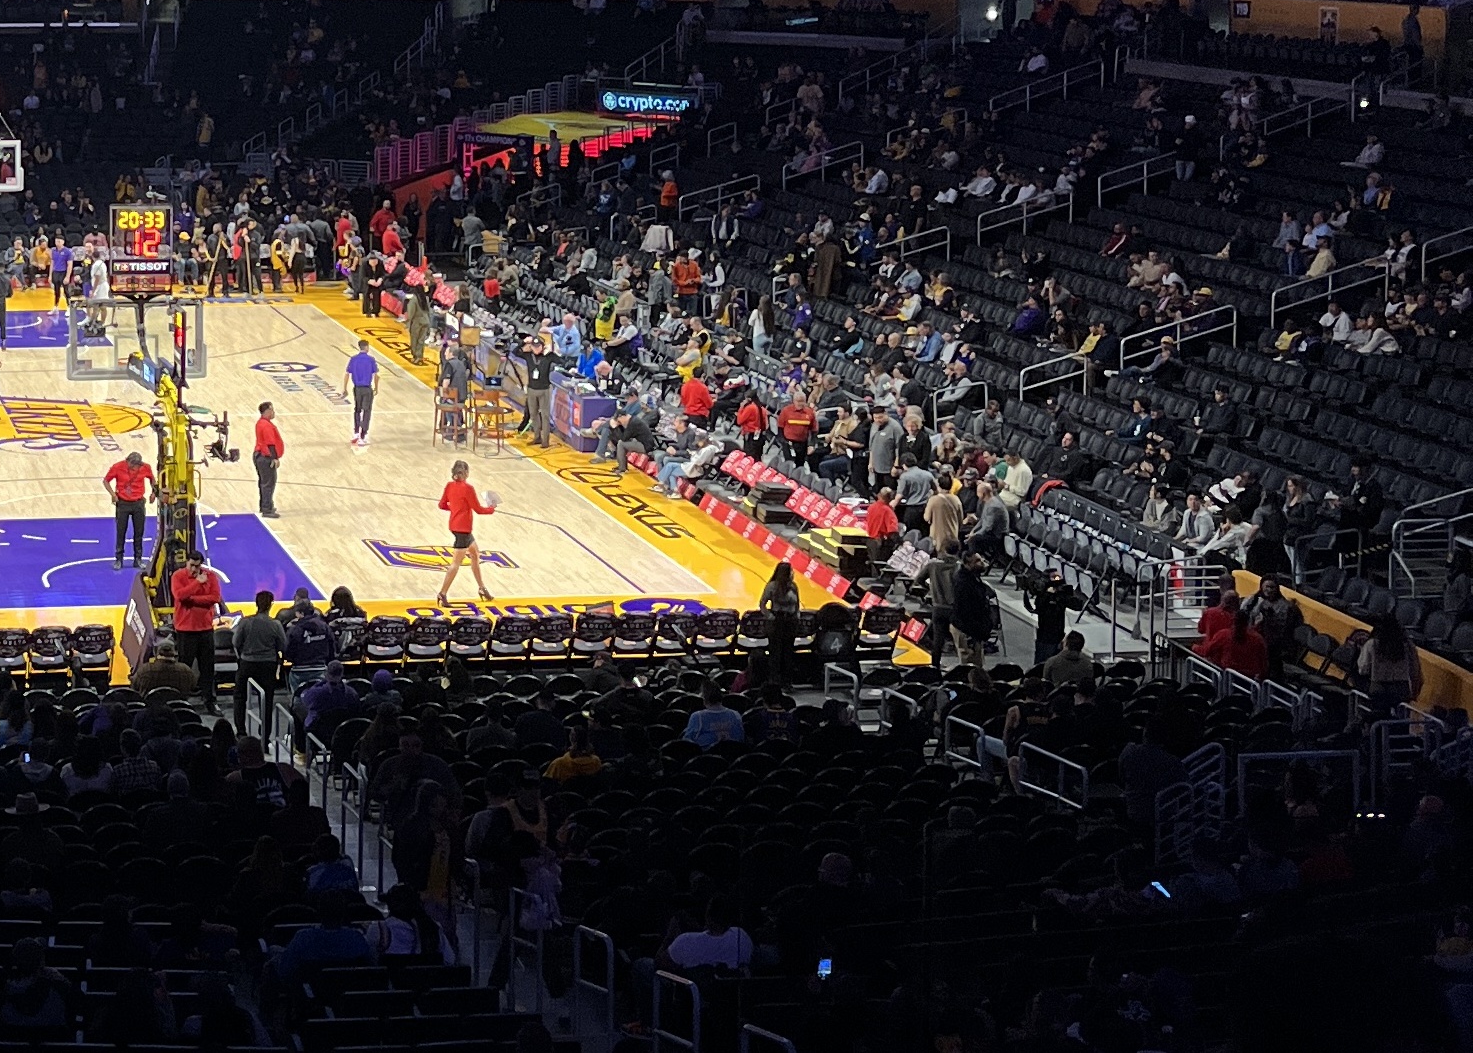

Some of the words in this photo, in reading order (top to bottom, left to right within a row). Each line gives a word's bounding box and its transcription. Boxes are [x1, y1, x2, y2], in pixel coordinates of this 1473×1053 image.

[118, 210, 165, 230] 20:33
[133, 229, 161, 258] 12
[129, 261, 169, 272] TISSOT
[591, 485, 693, 539] LEXUS
